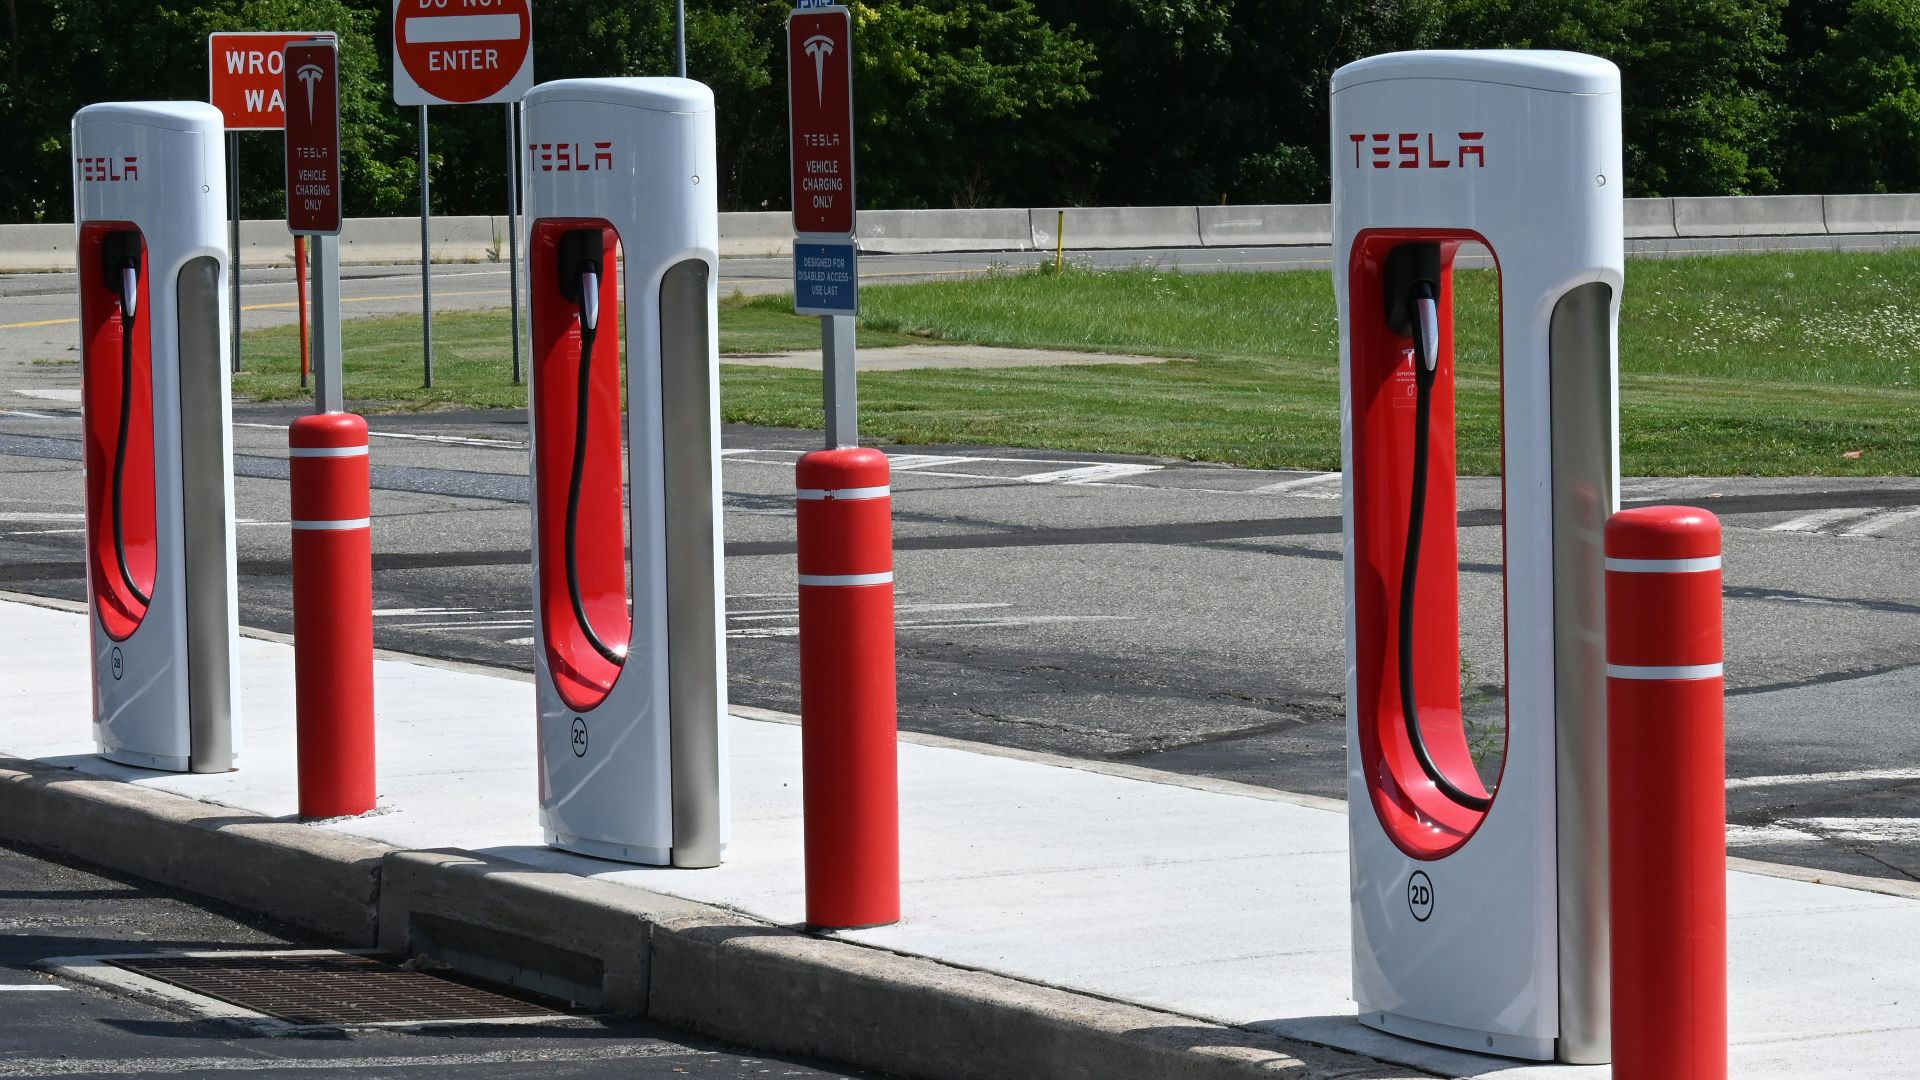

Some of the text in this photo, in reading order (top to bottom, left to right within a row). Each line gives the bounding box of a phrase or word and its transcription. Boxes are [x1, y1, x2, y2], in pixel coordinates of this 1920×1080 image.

[225, 50, 284, 75] WRO
[429, 48, 499, 71] ENTER
[244, 89, 285, 113] WA
[803, 133, 840, 146] TESLA
[296, 147, 328, 158] TESLA
[1349, 131, 1485, 169] TESLA
[529, 142, 612, 172] TESLA
[77, 156, 138, 181] TESLA
[806, 160, 838, 173] VEHICLE
[298, 169, 327, 181] VEHICLE
[295, 184, 331, 196] CHARGING
[802, 177, 843, 191] CHARGING
[304, 199, 322, 210] ONLY
[812, 195, 833, 208] ONLY
[803, 256, 845, 268] DESIGNED FOR
[797, 270, 849, 282] DISABLED ACCESS
[811, 285, 838, 296] USE LAST
[573, 728, 585, 745] 2C
[1411, 885, 1430, 905] 2D
